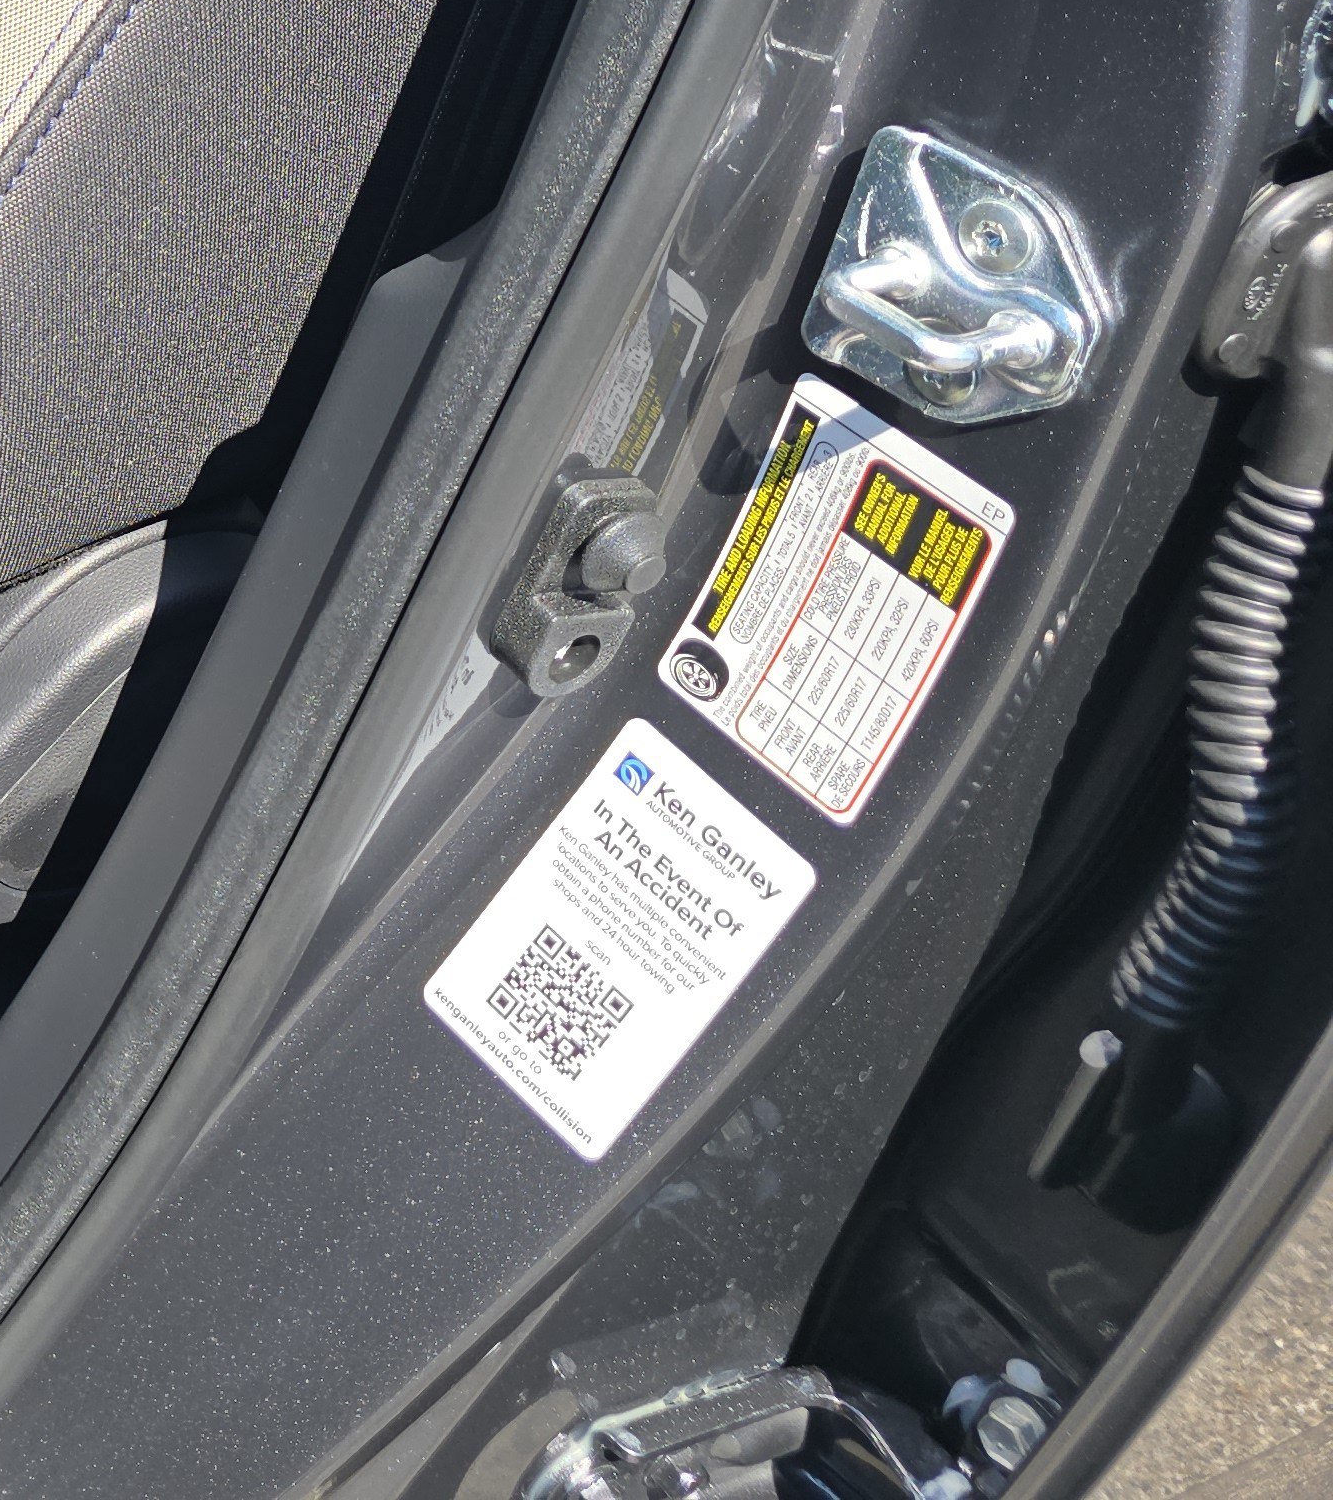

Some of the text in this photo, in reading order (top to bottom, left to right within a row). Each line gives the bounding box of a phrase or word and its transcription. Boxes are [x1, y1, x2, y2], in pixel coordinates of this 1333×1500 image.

[807, 457, 822, 482] REAR
[822, 448, 832, 458] 3
[706, 418, 815, 633] RENSEIGNEMENTS SUR LES PNEUS ET LE CHARGEMENT
[712, 438, 792, 594] TIRE AND LOADING INFORMATION
[788, 495, 805, 522] FRONT
[797, 502, 814, 529] AVANT
[803, 491, 814, 502] 2
[852, 471, 887, 532] SEE OWNER'S
[863, 480, 897, 539] MANUAL FOR
[874, 488, 907, 544] ADDITIONAL
[884, 492, 919, 555] INFORMATION
[980, 500, 1007, 525] EP
[776, 529, 796, 560] TOTAL 5
[907, 505, 949, 580] VOIR LE MANUEL
[922, 520, 956, 580] DE L'USAGER
[931, 525, 969, 591] POUR PLUS DE
[938, 525, 983, 606] RENSEIGNEMENTS
[731, 562, 774, 635] SEATING CAPACITY
[740, 565, 784, 642] NOMBRE DE PLACES
[802, 535, 850, 621] COLD TIRE PRESSURE
[817, 554, 853, 615] PRESSION DES
[824, 591, 846, 623] PNEUS
[842, 559, 862, 587] FROID
[842, 574, 883, 641] 230KPA, 33PSI
[781, 642, 800, 666] SIZE
[869, 595, 910, 662] 220KPA, 32PSI
[899, 616, 940, 684] 420KPA, 60PSI
[781, 633, 819, 691] DIMENSIONS
[806, 654, 841, 706] 225/60R17
[748, 698, 767, 722] TIRE
[757, 705, 778, 733] PNEU
[833, 674, 868, 727] 225/60R17
[773, 716, 797, 750] FRONT
[783, 725, 807, 757] AVANT
[801, 740, 823, 768] REAR
[826, 759, 851, 791] SPARE
[830, 756, 866, 809] DE SECOURS
[592, 798, 744, 939] In The Event Of
[643, 798, 736, 882] AUTOMOTIVE GROUP
[651, 780, 785, 906] Ken Ganley
[554, 840, 711, 987] locations to serve you. To quickly
[557, 823, 728, 982] Ken Ganley has multiple convenient
[592, 826, 716, 941] An Accident
[550, 856, 696, 993] obtain a phone number for our
[550, 876, 677, 995] shops and 24 hour towing
[583, 937, 613, 966] scan
[431, 985, 594, 1145] kenganleyauto.com/collision
[496, 1028, 544, 1076] or go to
